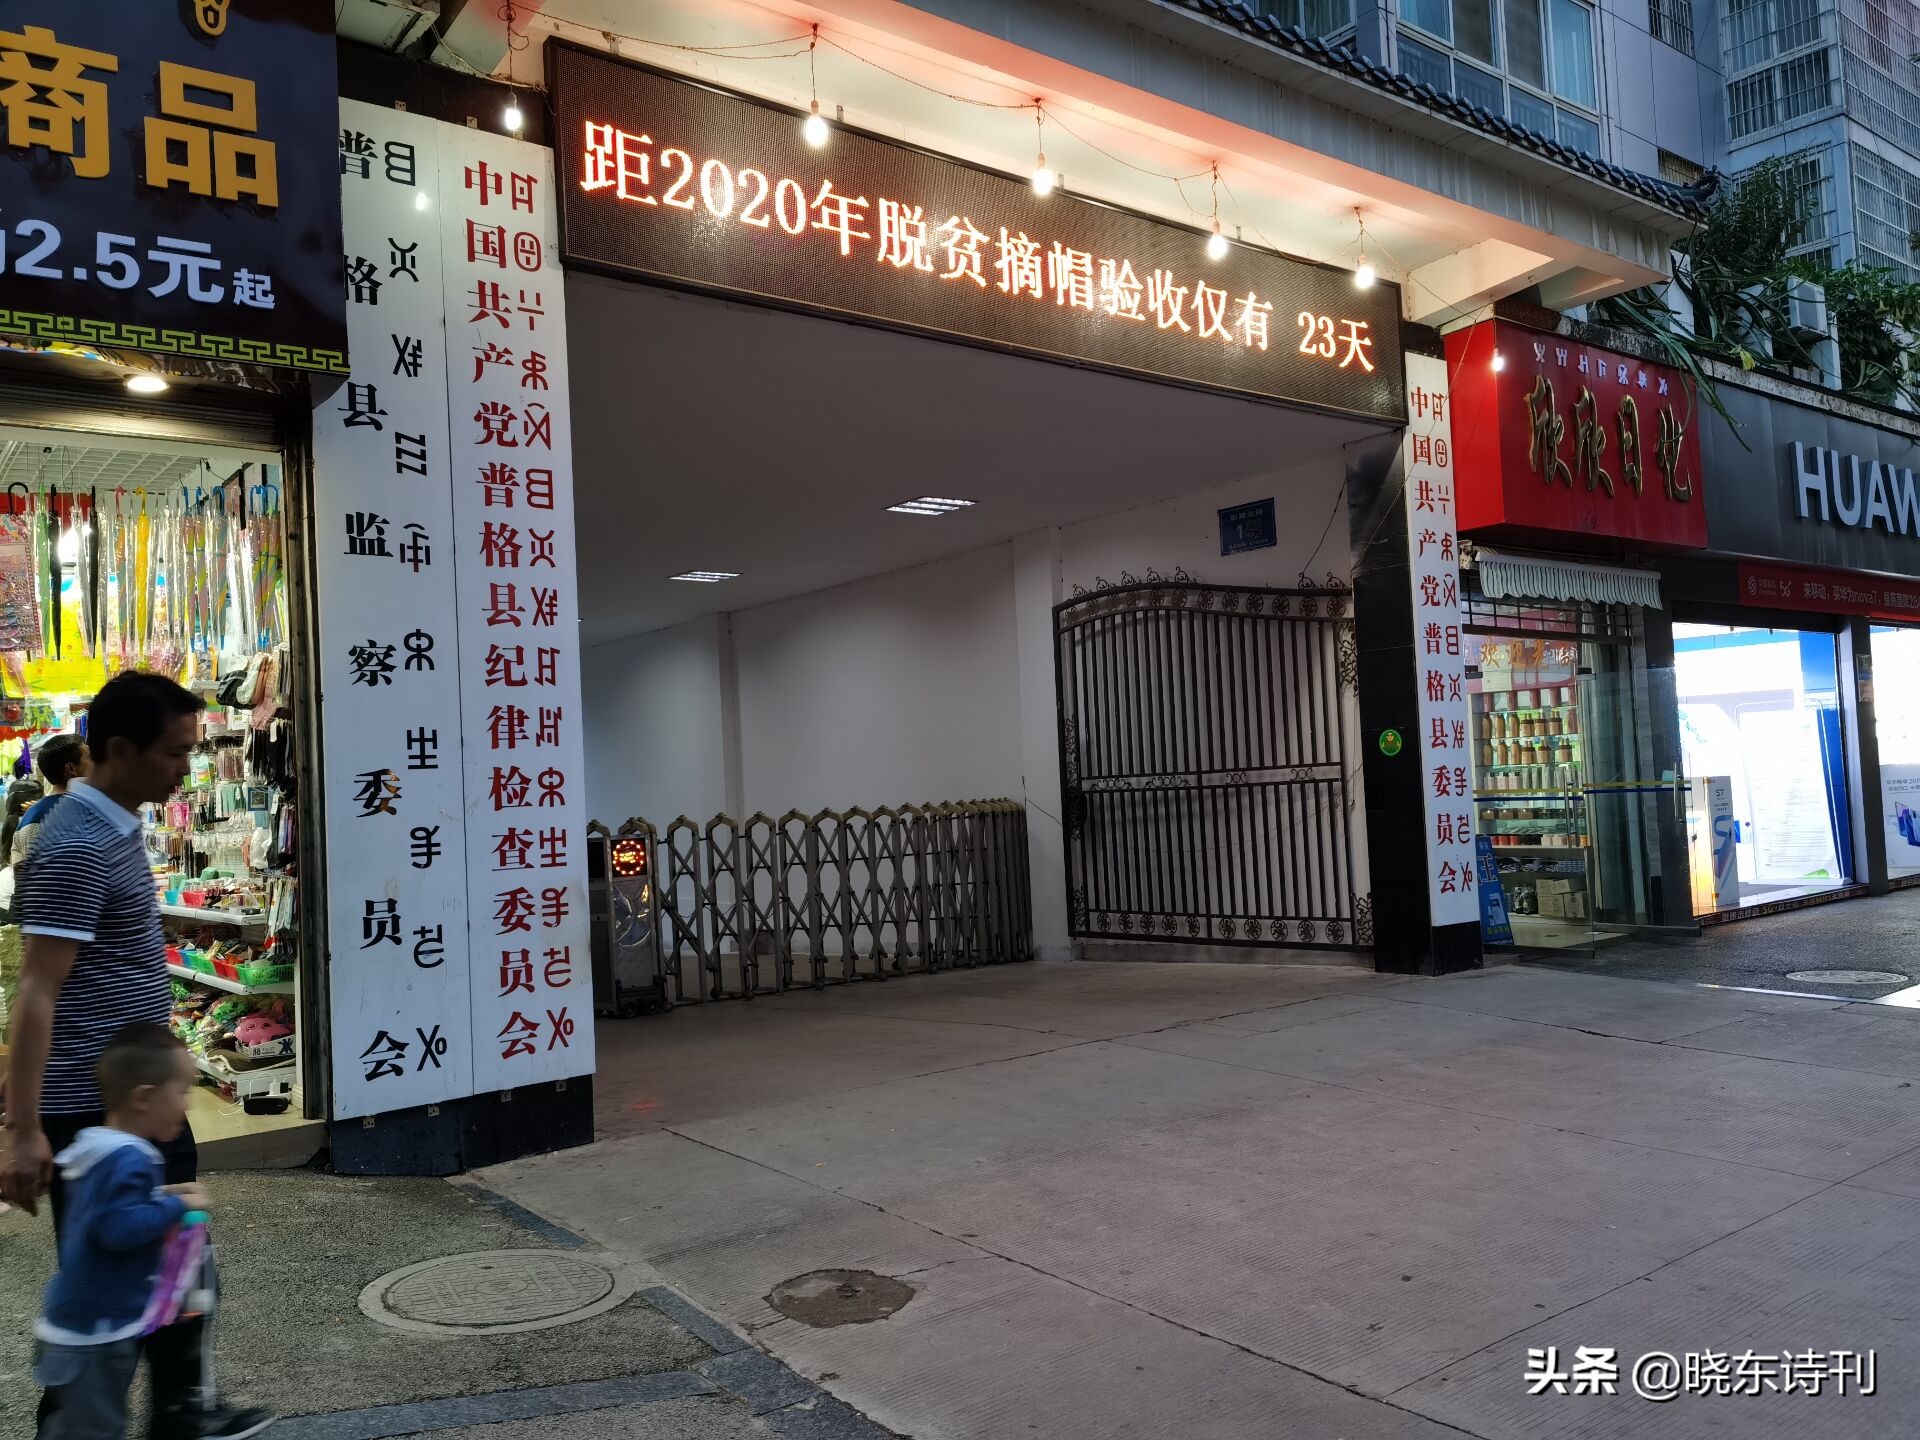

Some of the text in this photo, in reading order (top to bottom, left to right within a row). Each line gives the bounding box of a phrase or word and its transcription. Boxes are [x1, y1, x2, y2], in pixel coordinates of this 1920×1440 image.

[0, 25, 279, 208] 商品
[0, 218, 276, 310] 2.5元起
[579, 119, 1375, 371] 距2020年脱贫摘帽验收仅有 23天
[338, 129, 410, 1082] 普格县监察委员会
[464, 160, 541, 1060] 中国共产党普格县纪律检查委员会
[1791, 441, 1920, 538] HUAW
[1410, 385, 1457, 894] 中国共产党普格县委员会
